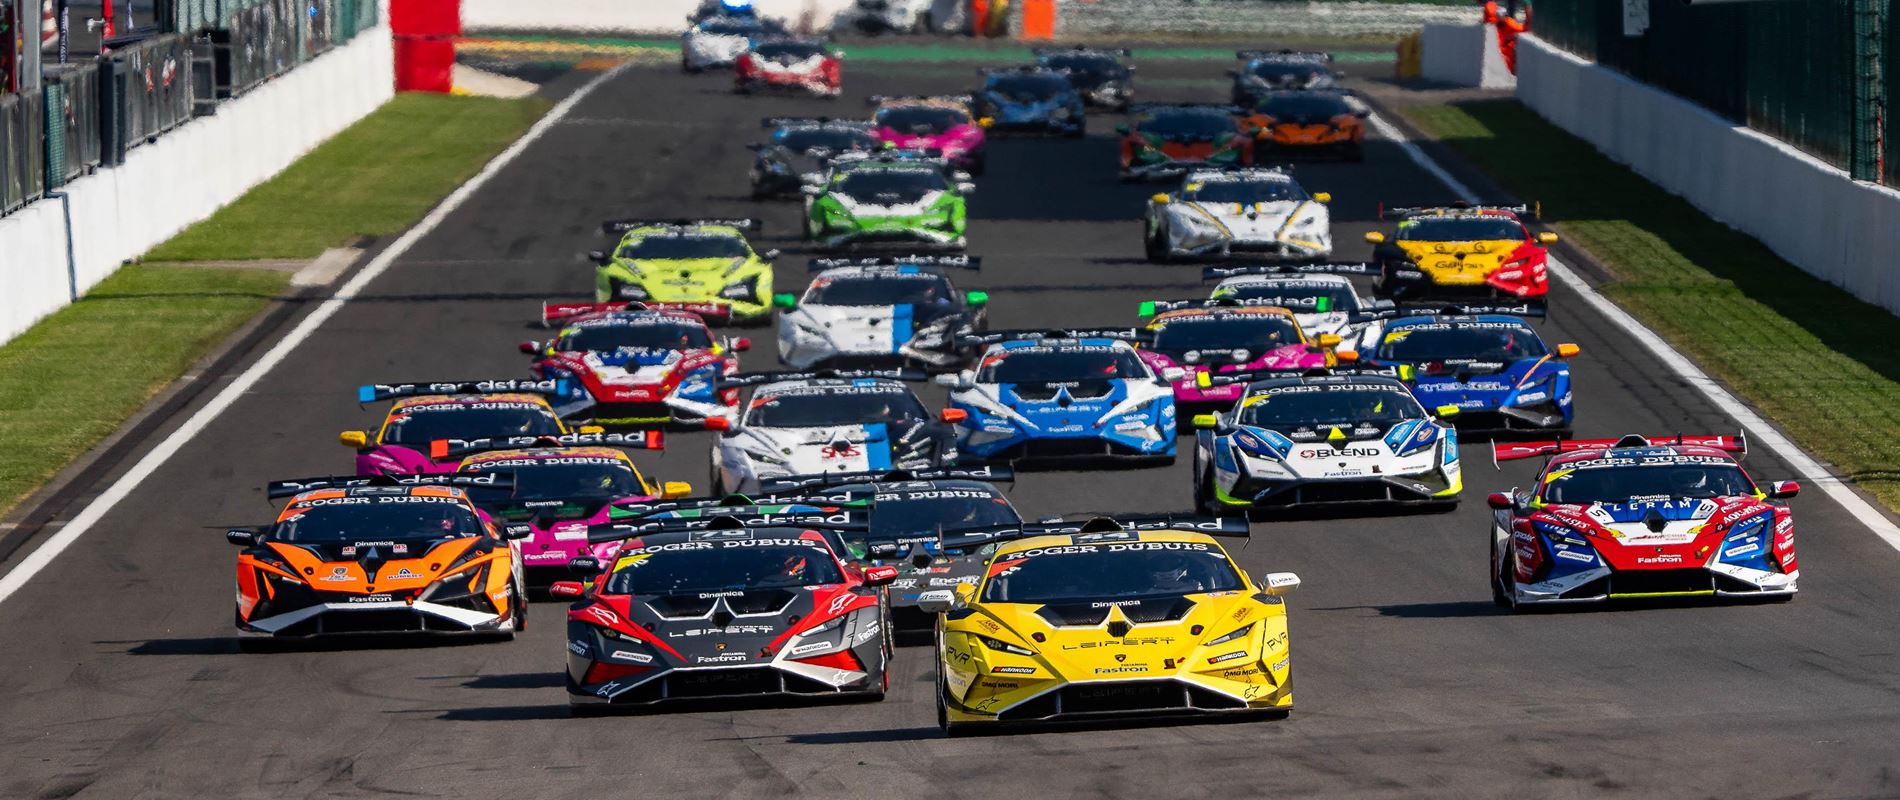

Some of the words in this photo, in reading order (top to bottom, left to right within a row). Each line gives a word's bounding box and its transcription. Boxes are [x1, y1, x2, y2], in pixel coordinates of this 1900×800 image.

[1254, 385, 1323, 396] ROGER
[1328, 383, 1400, 392] DUBUIS
[400, 403, 465, 414] ROGER
[471, 402, 541, 411] DUBUIS
[1316, 447, 1380, 458] BLEND
[468, 458, 538, 470] ROGER
[544, 457, 622, 466] DUBUIS
[1560, 458, 1636, 470] ROGER
[1644, 456, 1725, 464] DUBUIS
[347, 473, 496, 486] radstad
[908, 489, 992, 500] DUBUIS
[296, 497, 371, 508] ROGER
[378, 496, 459, 505] DUBUIS
[686, 511, 850, 528] radstad
[627, 541, 714, 556] ROGER
[723, 538, 816, 549] DUBUIS
[1006, 545, 1099, 561] ROGER
[1108, 542, 1208, 552] DUBUIS
[699, 590, 744, 599] Dinamica
[1091, 600, 1141, 609] Dinamica
[697, 655, 747, 663] Fastron
[1216, 651, 1247, 662] HANKOOK
[1094, 666, 1149, 675] Fastron
